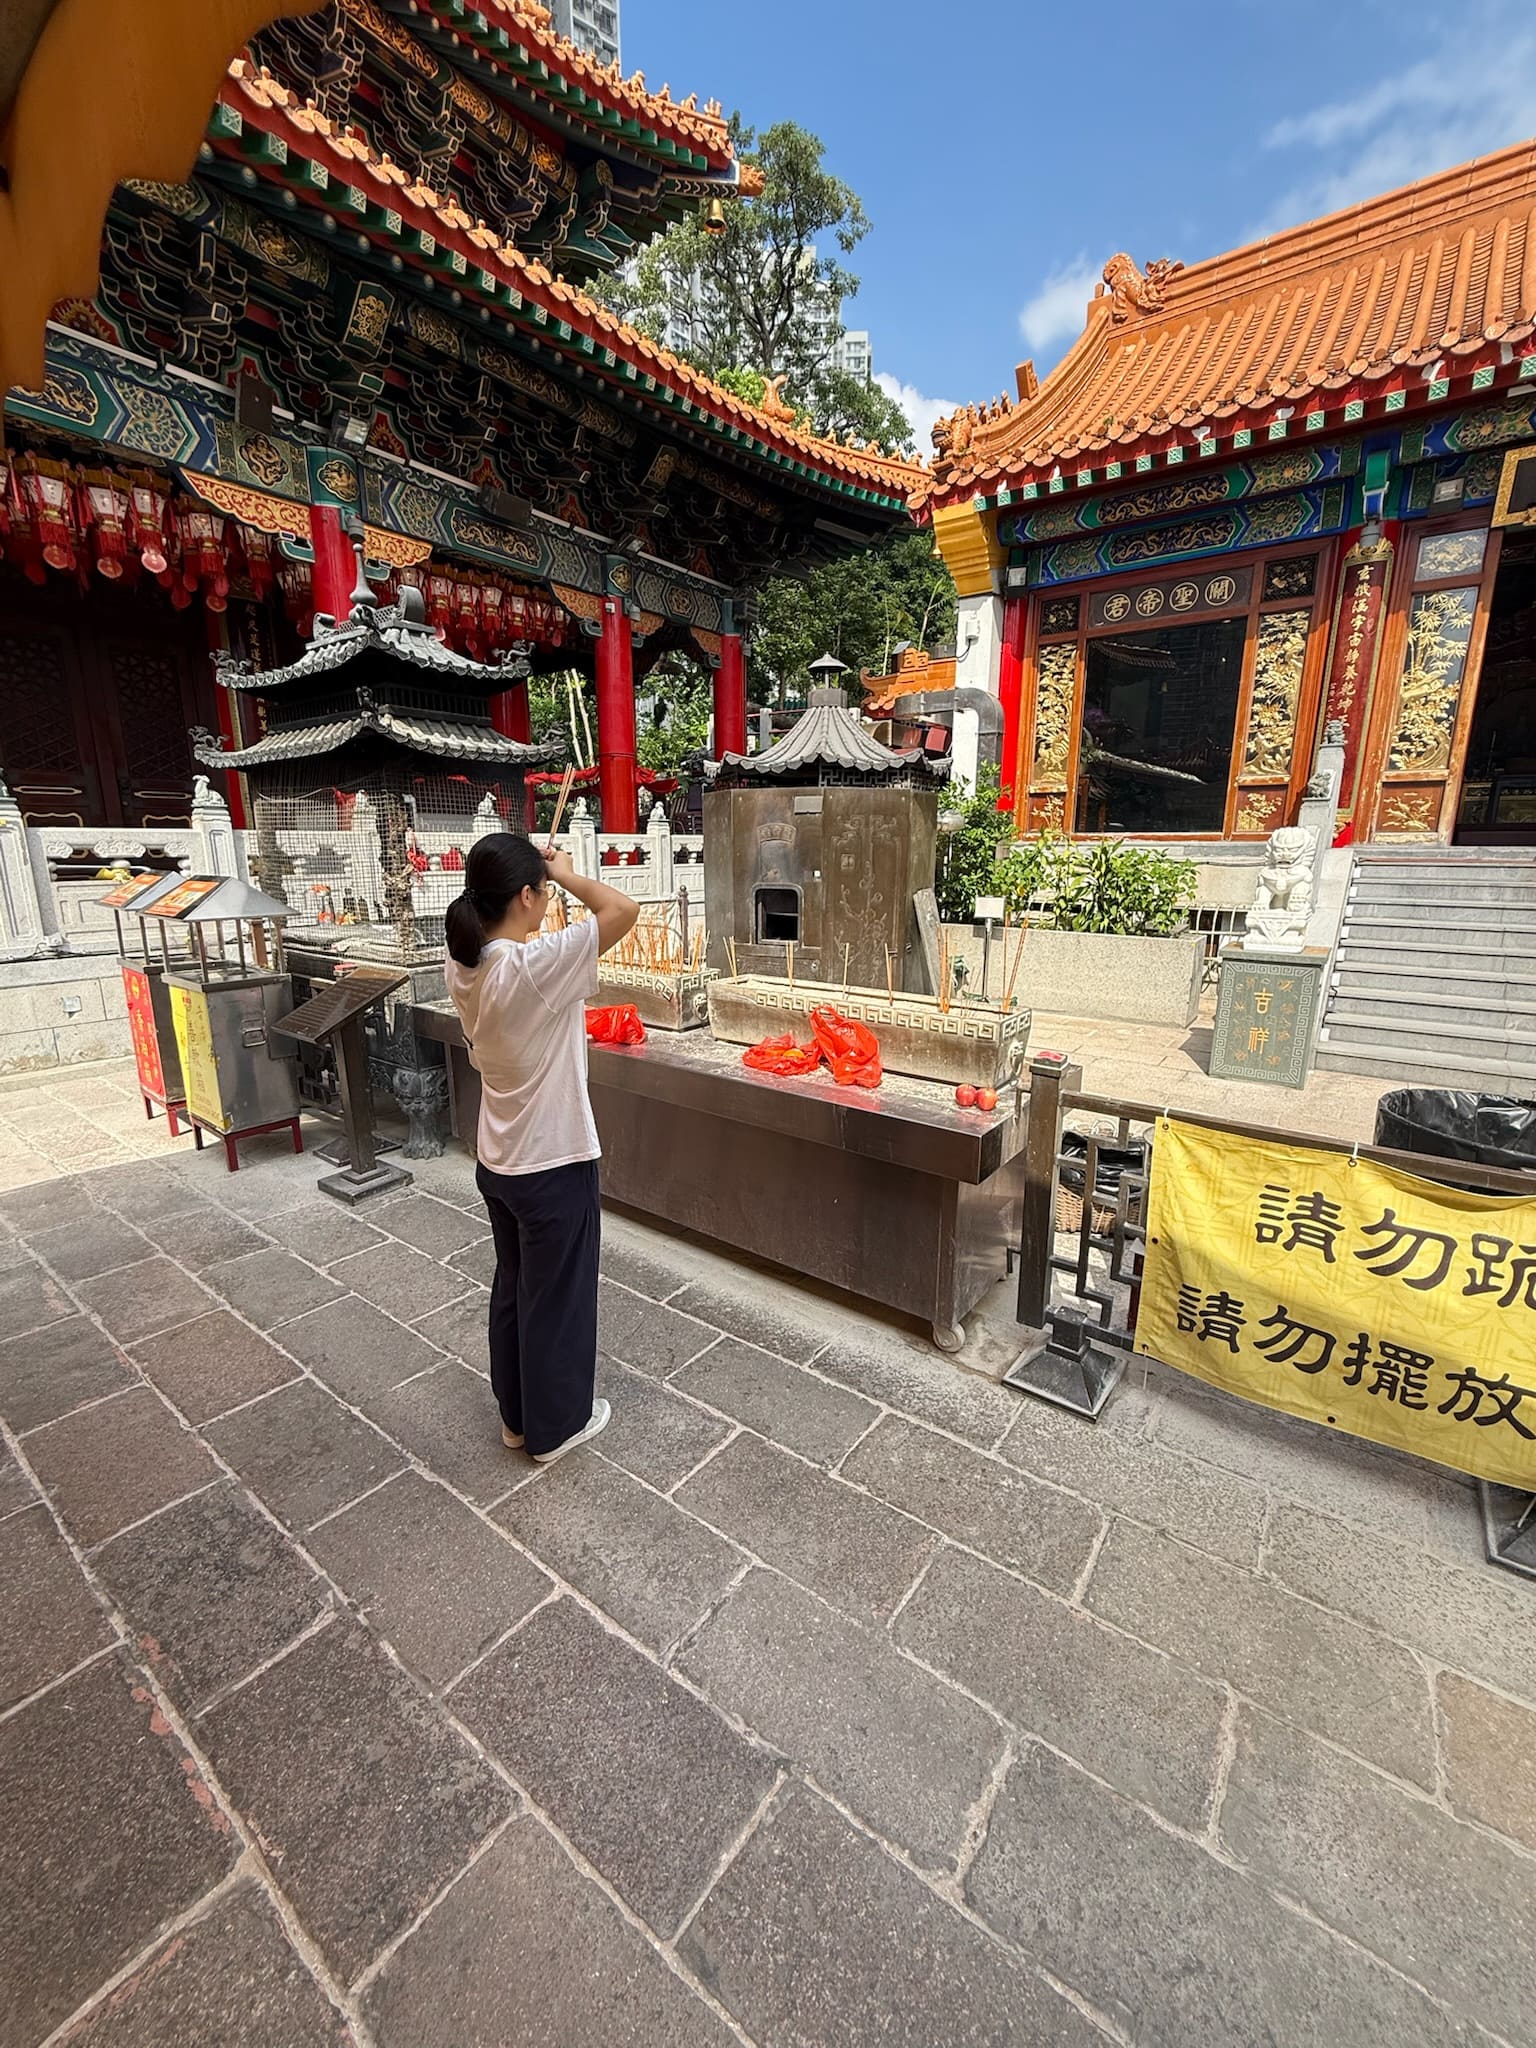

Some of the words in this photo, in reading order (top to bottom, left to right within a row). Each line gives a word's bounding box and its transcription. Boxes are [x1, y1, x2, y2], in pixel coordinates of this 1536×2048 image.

[1246, 988, 1274, 1055] 吉祥
[1177, 1283, 1536, 1440] 請勿擺放
